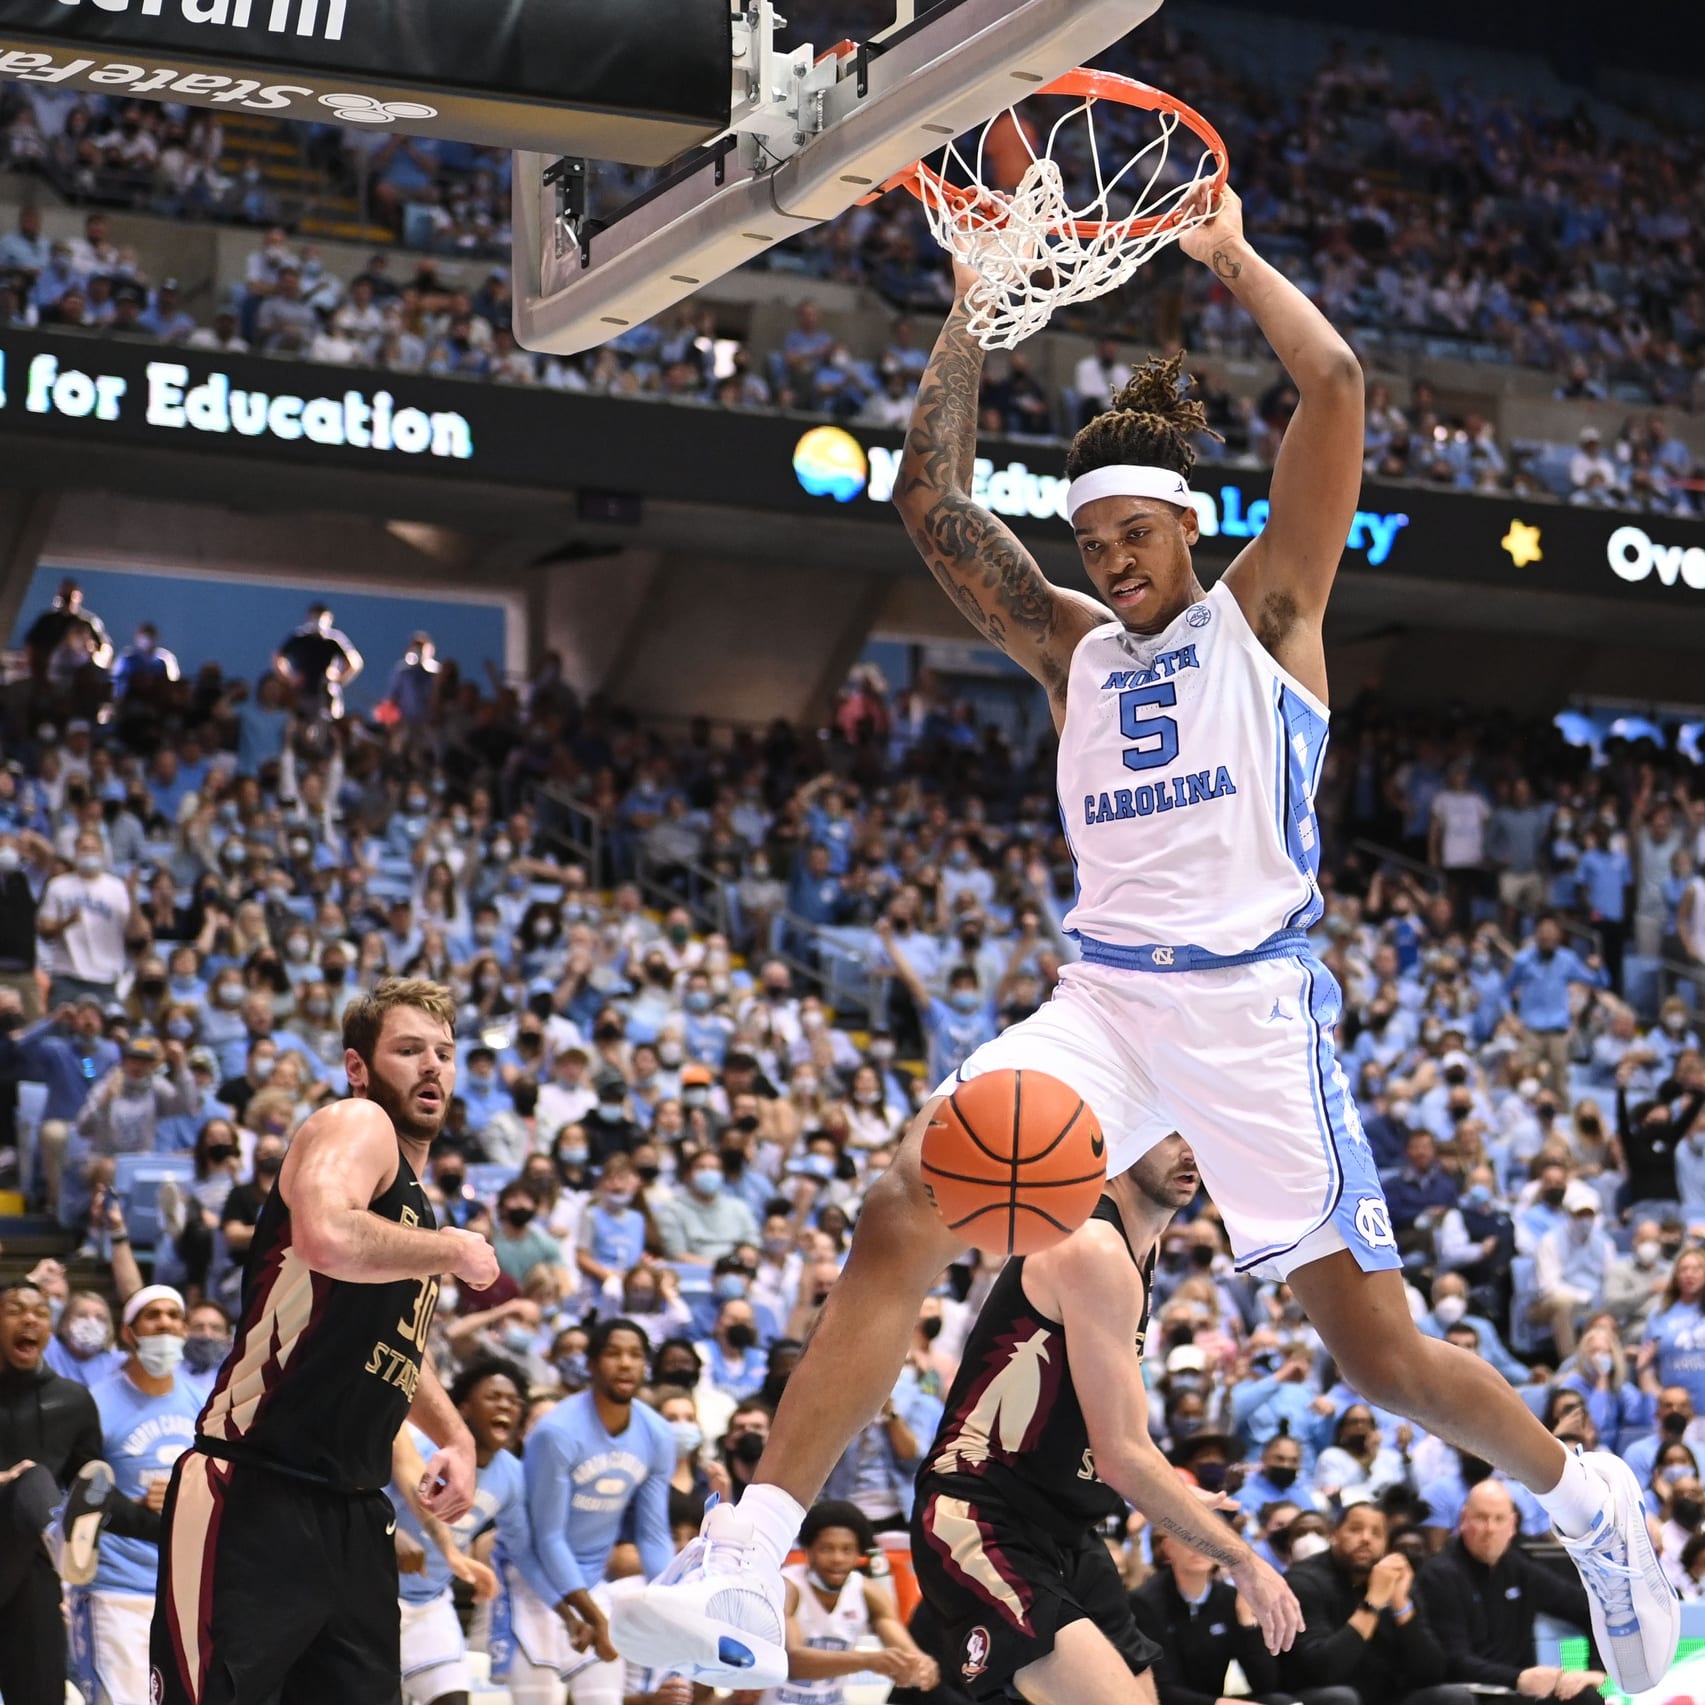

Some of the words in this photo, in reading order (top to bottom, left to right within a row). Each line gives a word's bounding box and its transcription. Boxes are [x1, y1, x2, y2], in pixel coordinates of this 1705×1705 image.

[0, 49, 97, 83] Fa
[88, 62, 315, 109] State
[26, 353, 127, 422] for
[145, 361, 475, 459] Education
[1118, 681, 1180, 772] 5
[1084, 765, 1237, 826] CAROLINA
